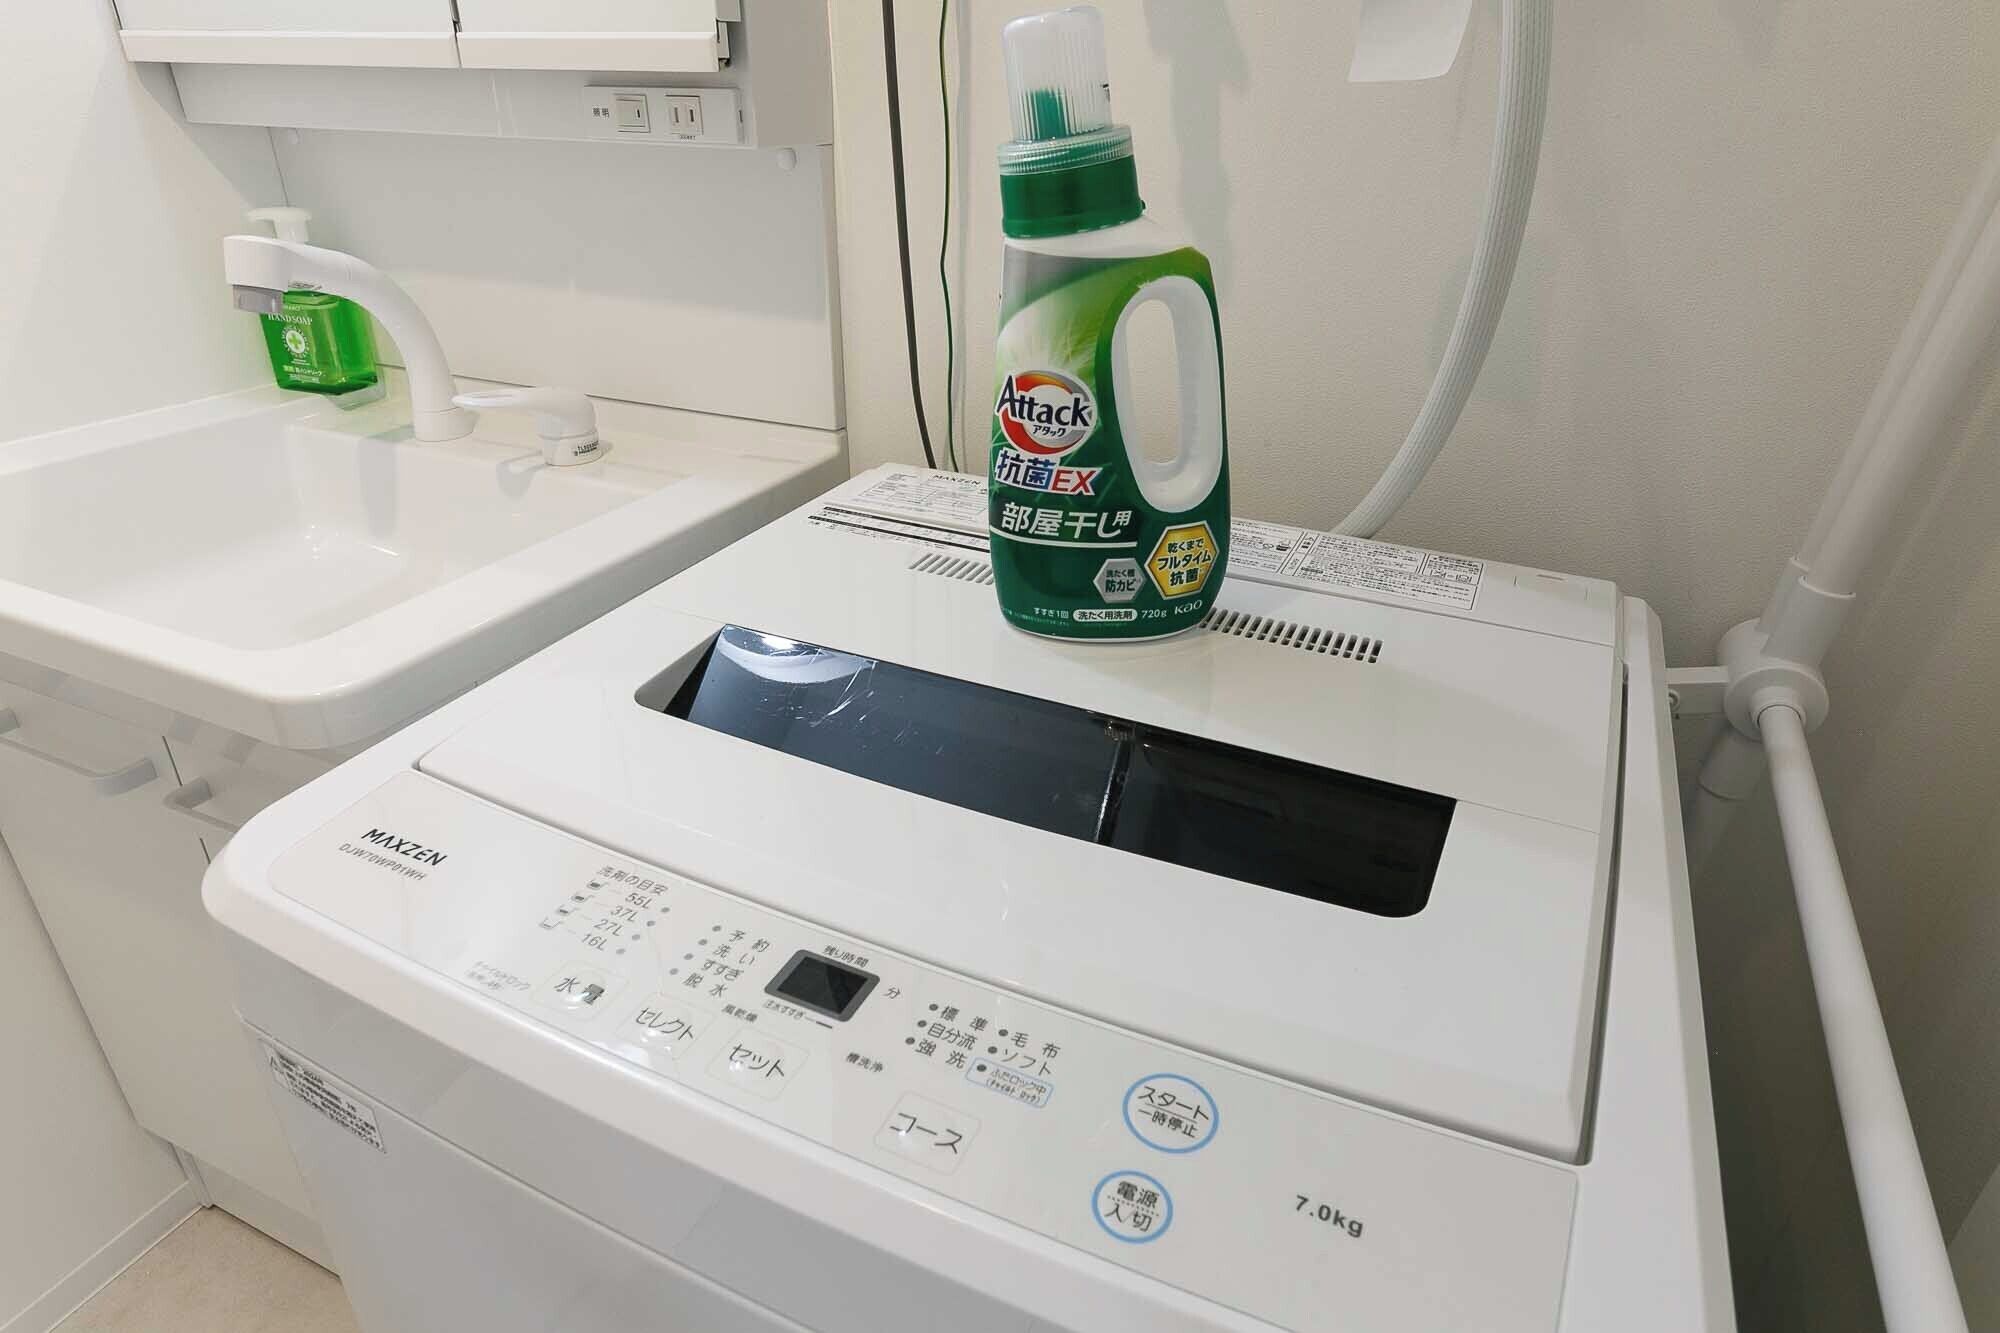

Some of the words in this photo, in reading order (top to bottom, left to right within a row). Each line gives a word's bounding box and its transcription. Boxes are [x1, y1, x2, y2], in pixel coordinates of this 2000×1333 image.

[997, 374, 1090, 427] Attack
[1032, 424, 1066, 437] アタック
[997, 450, 1099, 494] 抗菌EX
[1001, 502, 1132, 538] 部屋干し用
[1167, 538, 1204, 553] 乾くまで
[1157, 550, 1212, 570] フルタイム
[1105, 579, 1136, 592] 防カビ
[1170, 567, 1200, 586] 抗菌
[1077, 609, 1133, 620] 洗たく用洗剤
[361, 828, 447, 866] MAXZEN
[339, 843, 427, 880] DJW70WP01WH
[597, 865, 668, 896] 洗剤の目安
[611, 905, 638, 922] 37L
[625, 892, 652, 909] 55L
[593, 919, 622, 936] 27L
[582, 933, 608, 951] 16L
[702, 959, 744, 981] すすぎ
[823, 945, 870, 968] 残り時間
[883, 986, 901, 999] 分
[634, 1007, 694, 1041] セレクト
[927, 1022, 978, 1050] 自分流
[728, 1043, 785, 1078] セット
[1001, 1048, 1051, 1076] ソフト
[1137, 1085, 1210, 1121] スタート
[889, 1112, 963, 1154] コース
[1137, 1108, 1199, 1138] 一時停止
[1116, 1181, 1160, 1209] 電源
[1296, 1195, 1364, 1238] 7.0kg
